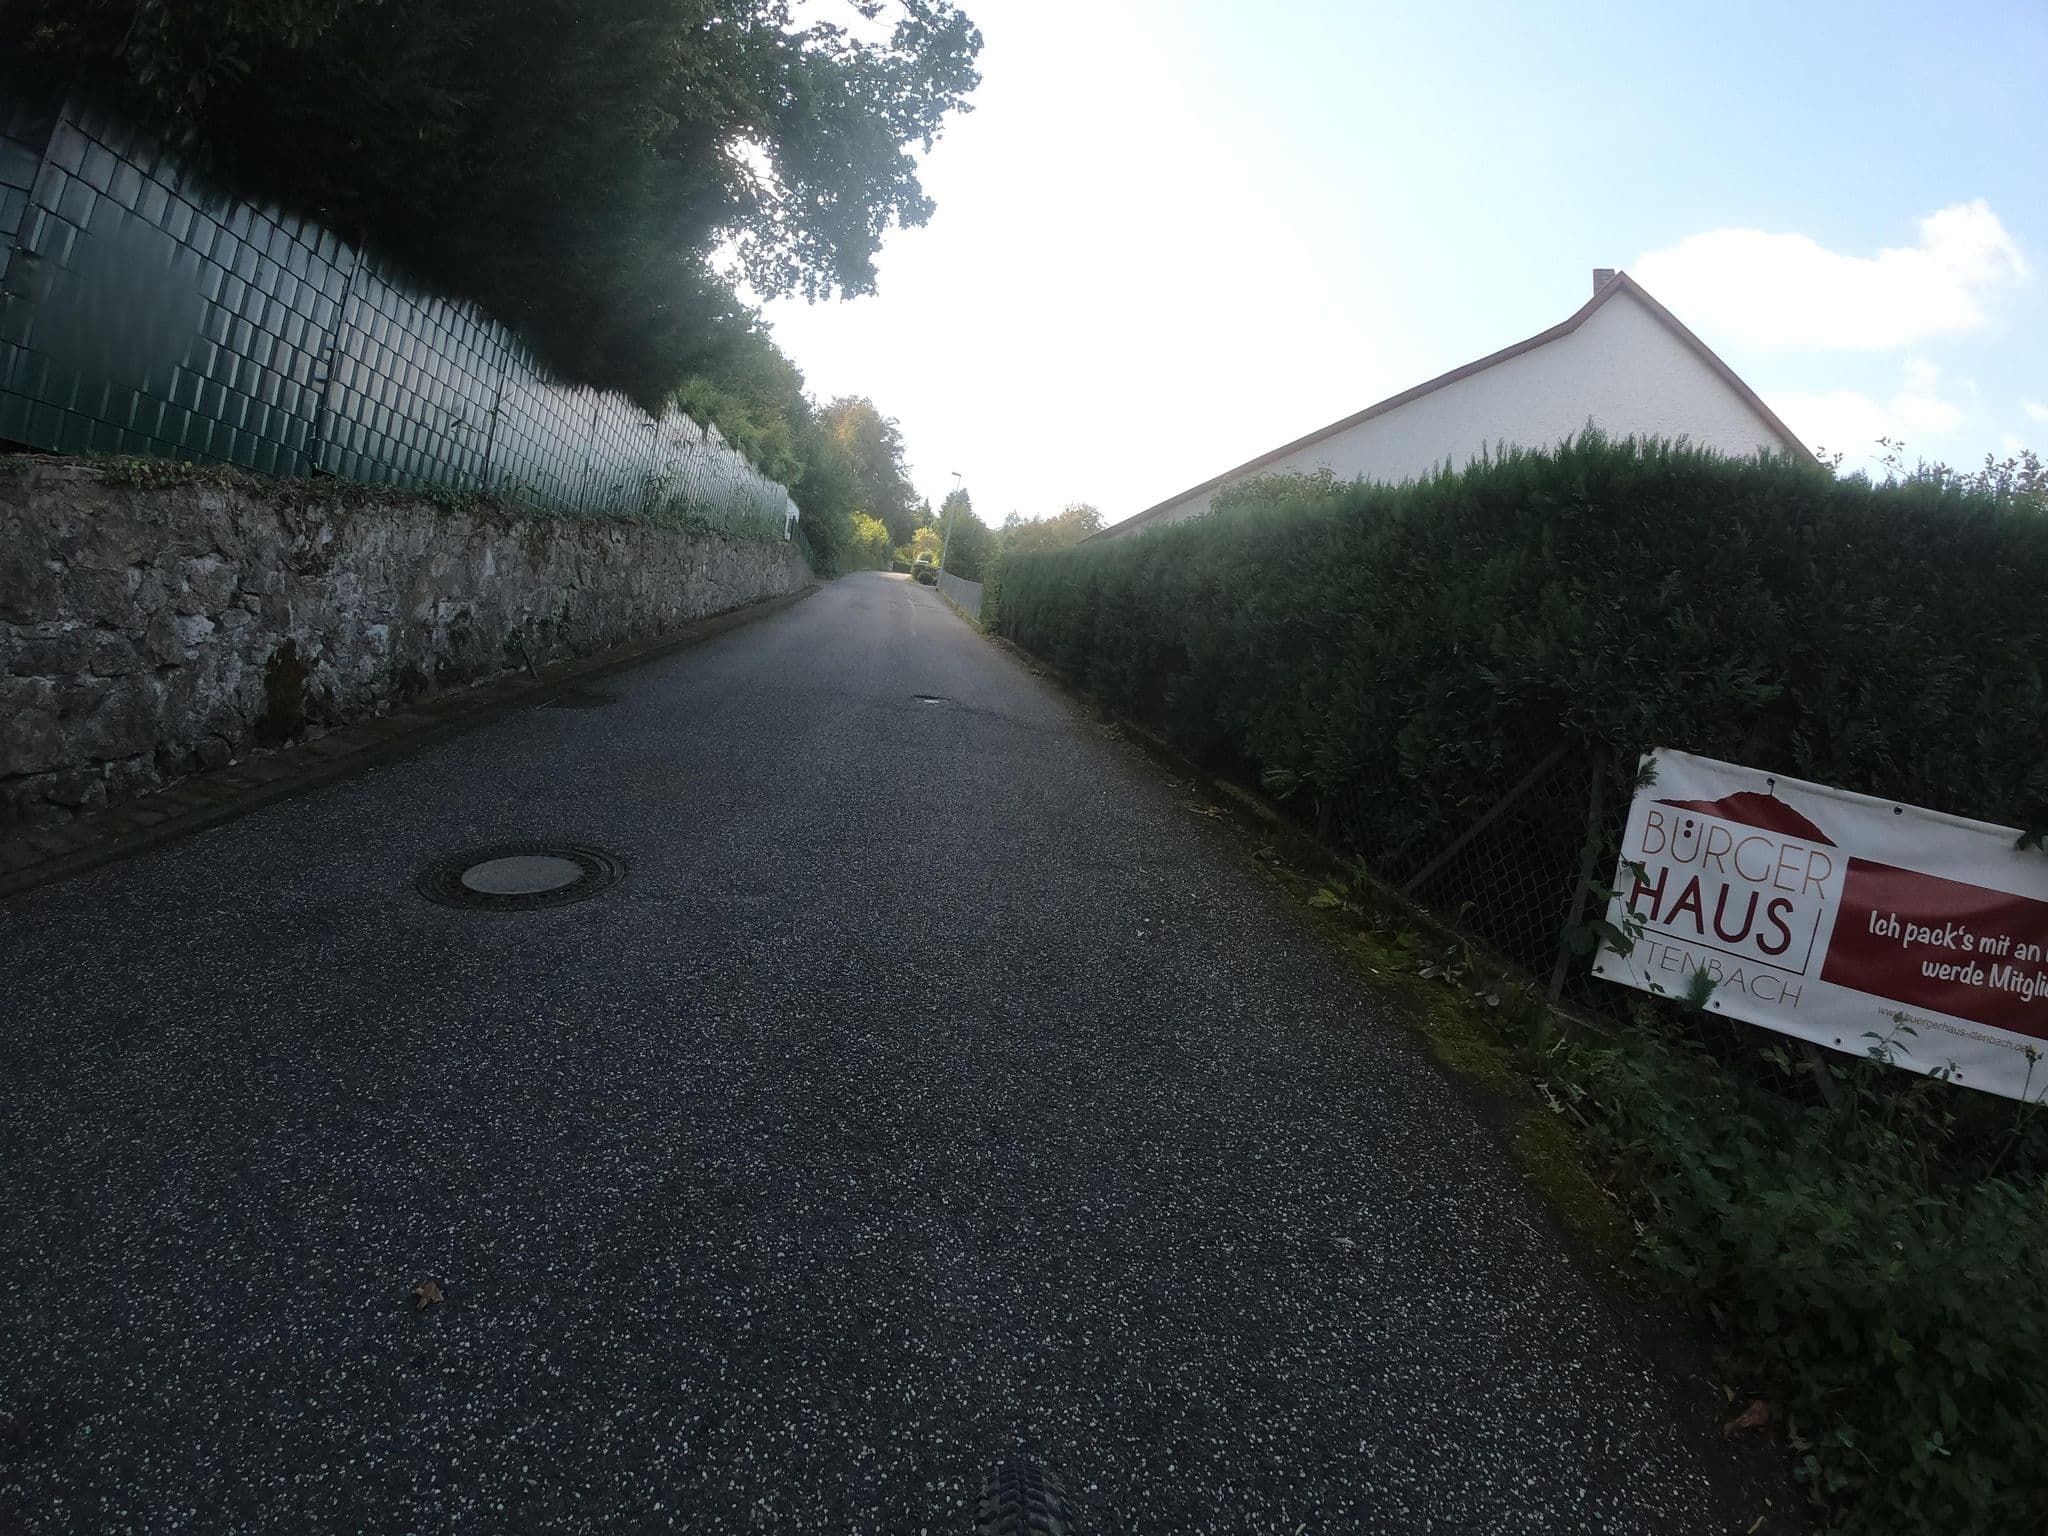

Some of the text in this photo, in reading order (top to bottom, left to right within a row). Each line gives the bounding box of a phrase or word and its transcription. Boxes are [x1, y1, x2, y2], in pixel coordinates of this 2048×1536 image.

[1641, 809, 1833, 899] BÜRGER
[1629, 860, 1795, 956] HAUS
[1868, 909, 1901, 939] Ich
[1978, 934, 2011, 956] mit
[2014, 942, 2041, 962] an
[1628, 935, 1803, 1008] TTENBACH
[1921, 960, 1985, 987] werde
